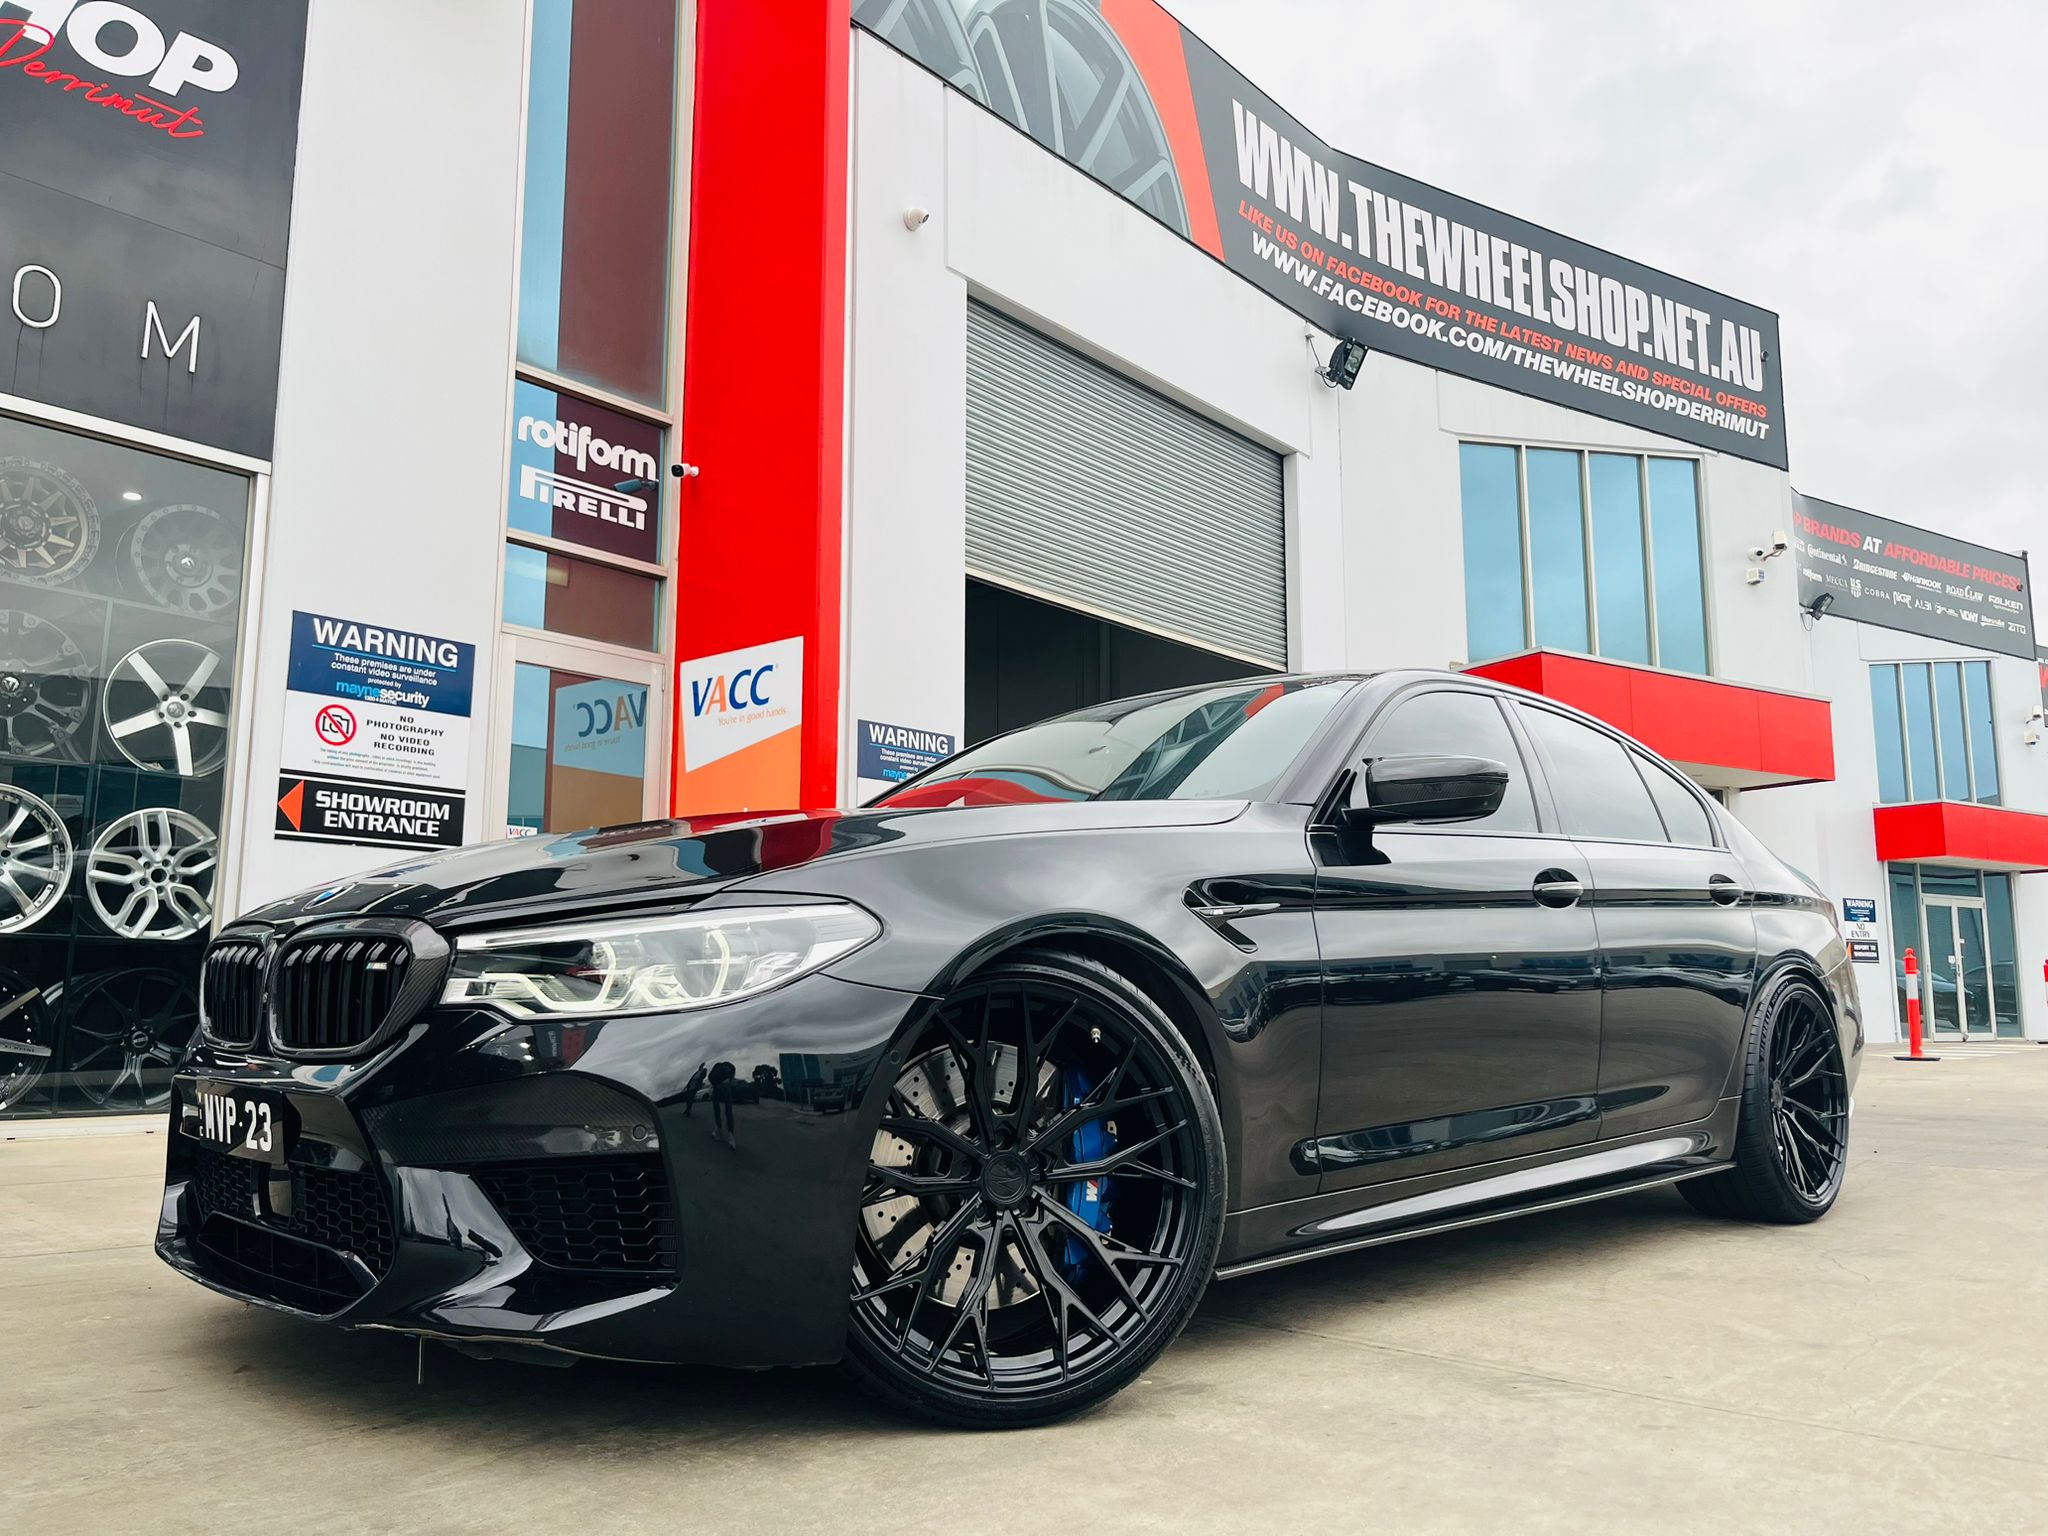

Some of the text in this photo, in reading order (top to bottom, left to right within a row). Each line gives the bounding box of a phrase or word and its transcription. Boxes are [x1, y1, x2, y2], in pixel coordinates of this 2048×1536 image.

[1232, 98, 1763, 392] WWW.THEWHEELSHOP.NET.AU
[1238, 200, 1767, 418] LIKE US ON FACEBOOK FOR THE LATEST NEWS AND SPECIAL OFFERS
[1253, 231, 1770, 440] WWW.FACEBOOK.COM/THEWHEELSHOPDERRIMUT
[518, 416, 658, 481] rotiform
[519, 464, 648, 531] PIRELLI
[1803, 516, 1861, 549] BRANDS
[1862, 535, 1883, 554] AT
[1883, 542, 1971, 579] AFFORDABLE
[1864, 587, 1890, 601] COBRA
[1988, 594, 2024, 611] FALKEN
[313, 617, 459, 668] WARNING
[331, 661, 438, 686] constant video surveillance
[334, 652, 437, 678] These premises are under
[394, 681, 402, 689] by
[691, 664, 775, 718] VACC
[366, 718, 445, 737] PHOTOGRAPHY
[399, 715, 415, 724] NO
[373, 741, 436, 757] RECORDING
[380, 732, 430, 747] NO VIDEO
[868, 723, 949, 755] WARNING
[315, 789, 450, 821] SHOWROOM
[323, 810, 440, 838] ENTRANCE
[1851, 930, 1870, 938] ENTRY
[1856, 923, 1866, 931] NO
